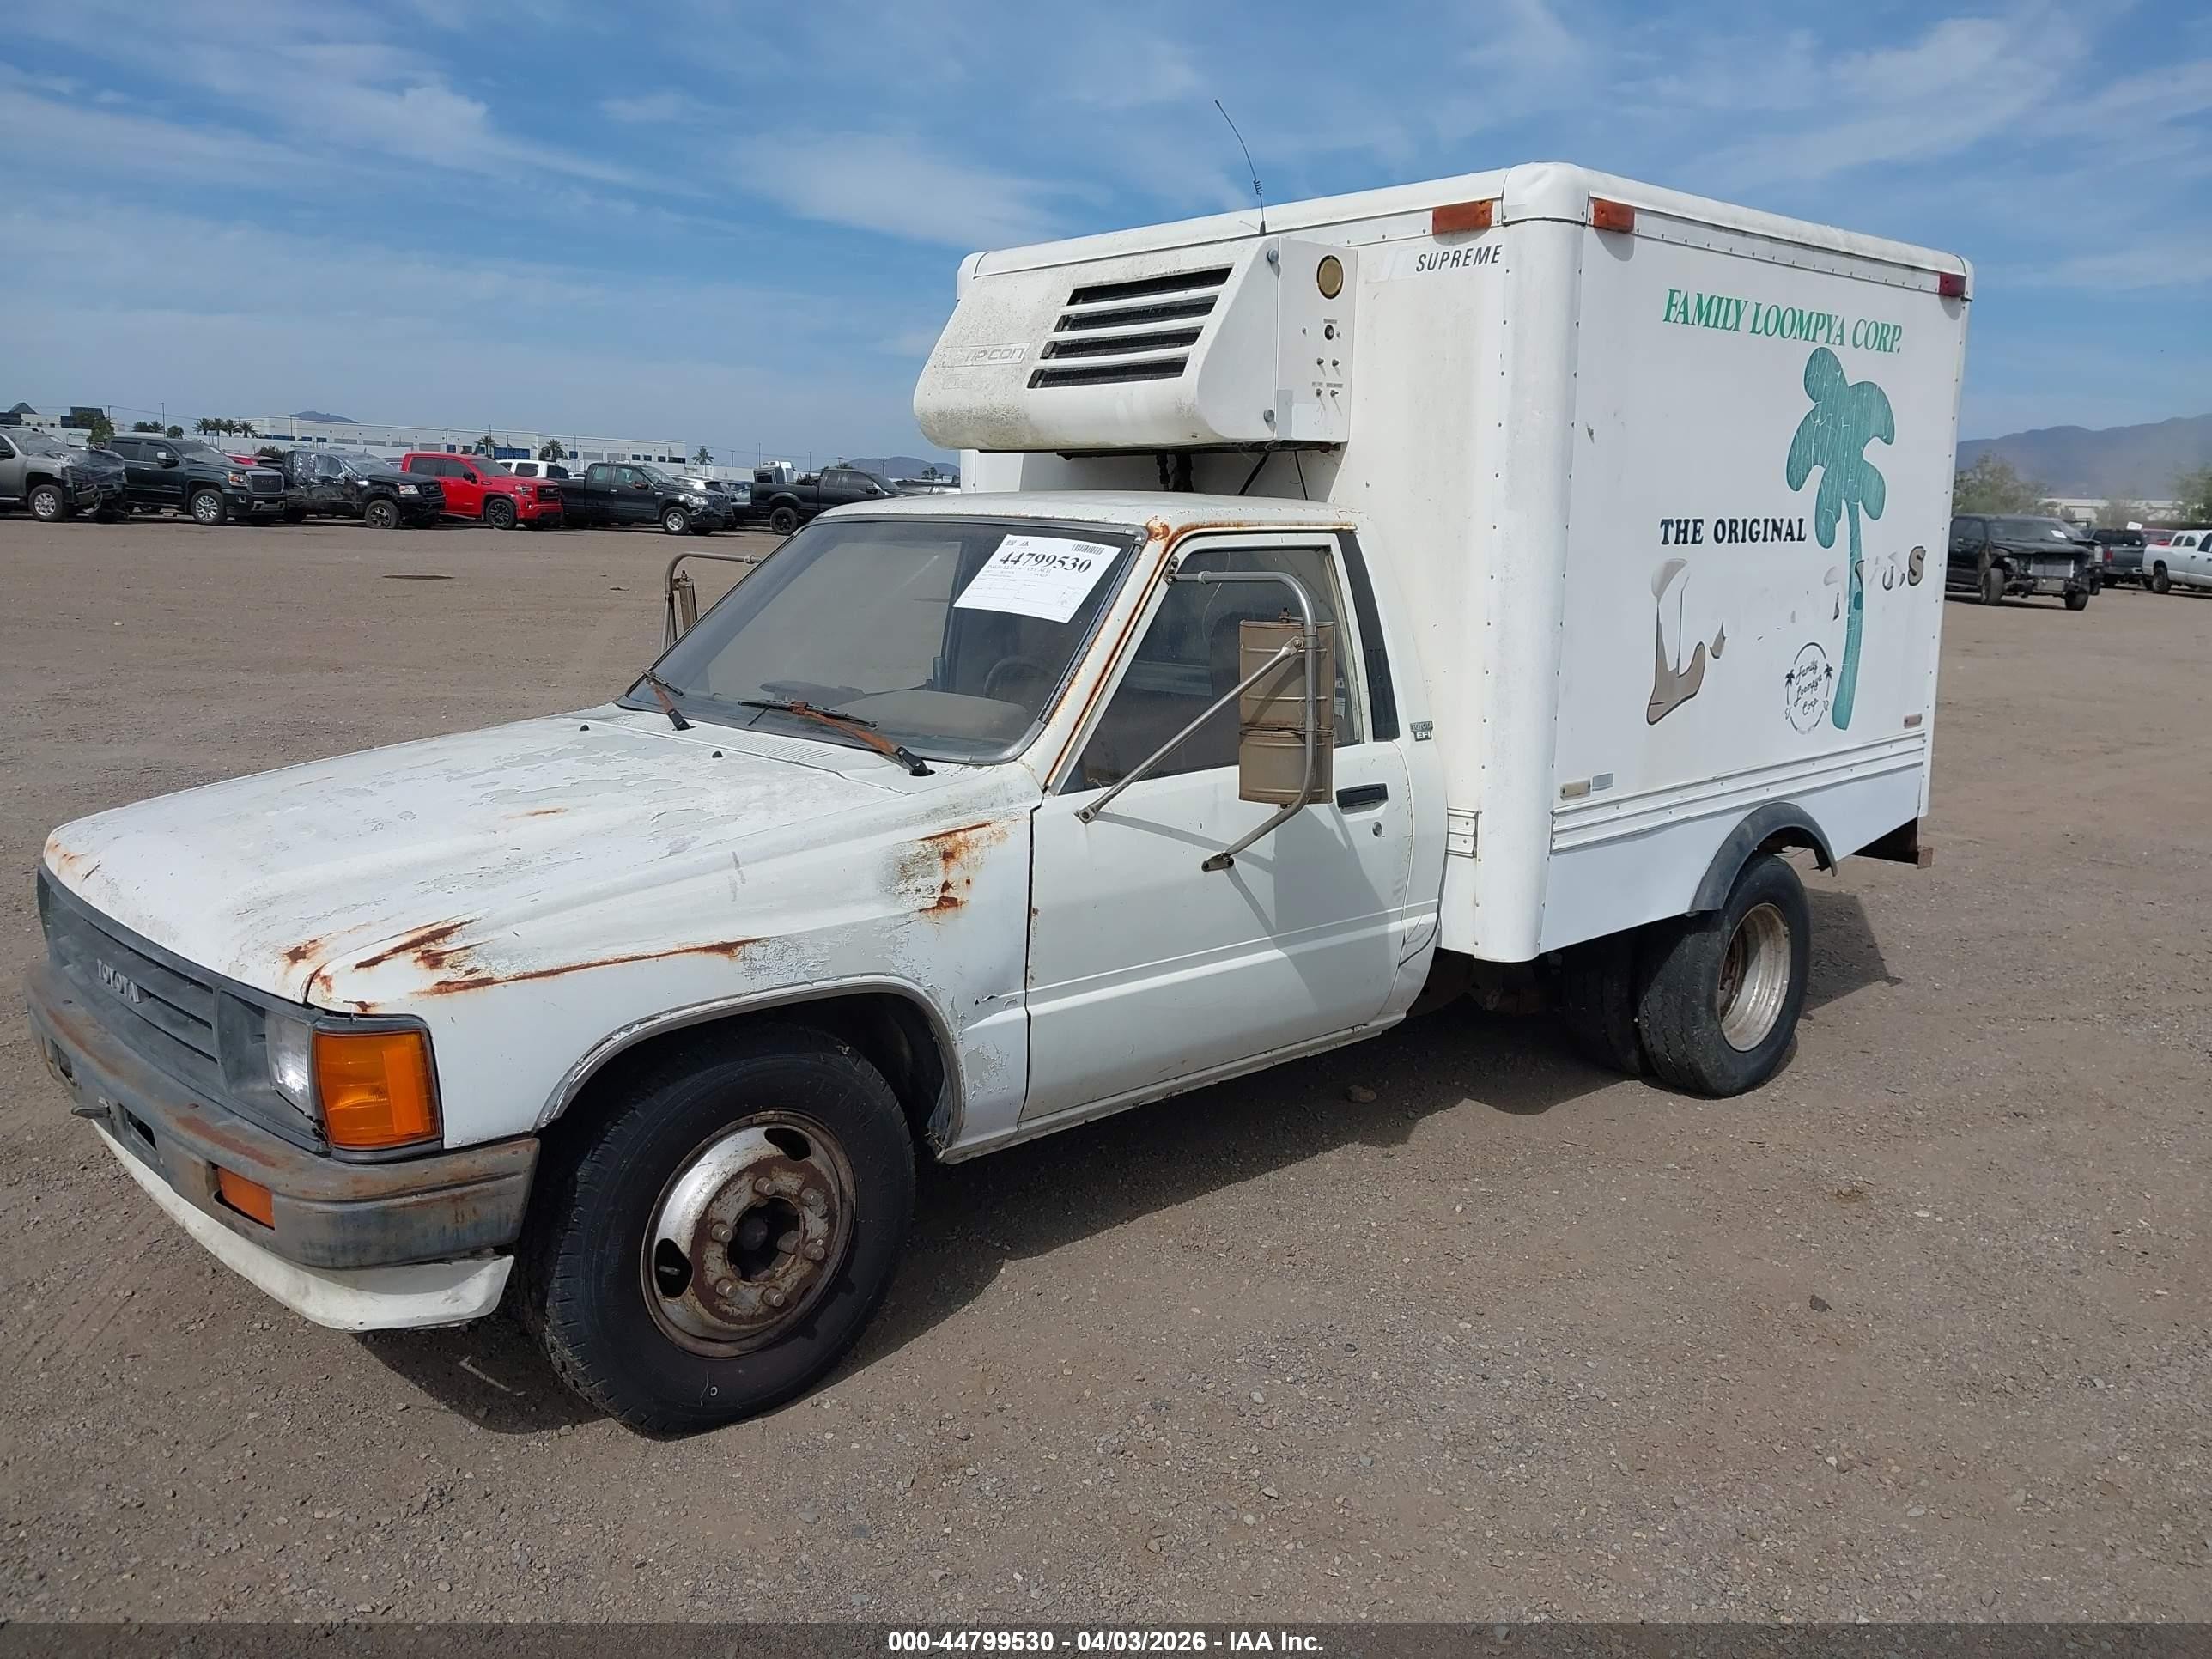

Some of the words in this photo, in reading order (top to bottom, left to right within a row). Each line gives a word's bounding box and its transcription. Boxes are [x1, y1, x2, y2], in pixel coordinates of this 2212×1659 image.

[1415, 244, 1503, 272] SUPREME
[1662, 288, 1748, 332] FAMILY
[1749, 301, 1845, 347] LOOMPYA
[1852, 318, 1903, 354] CORP.
[1660, 518, 1705, 545] THE
[1713, 517, 1808, 544] ORIGINAL
[1000, 550, 1092, 573] 44799530
[1416, 731, 1431, 739] EFI
[96, 957, 140, 1003] TOYOTA
